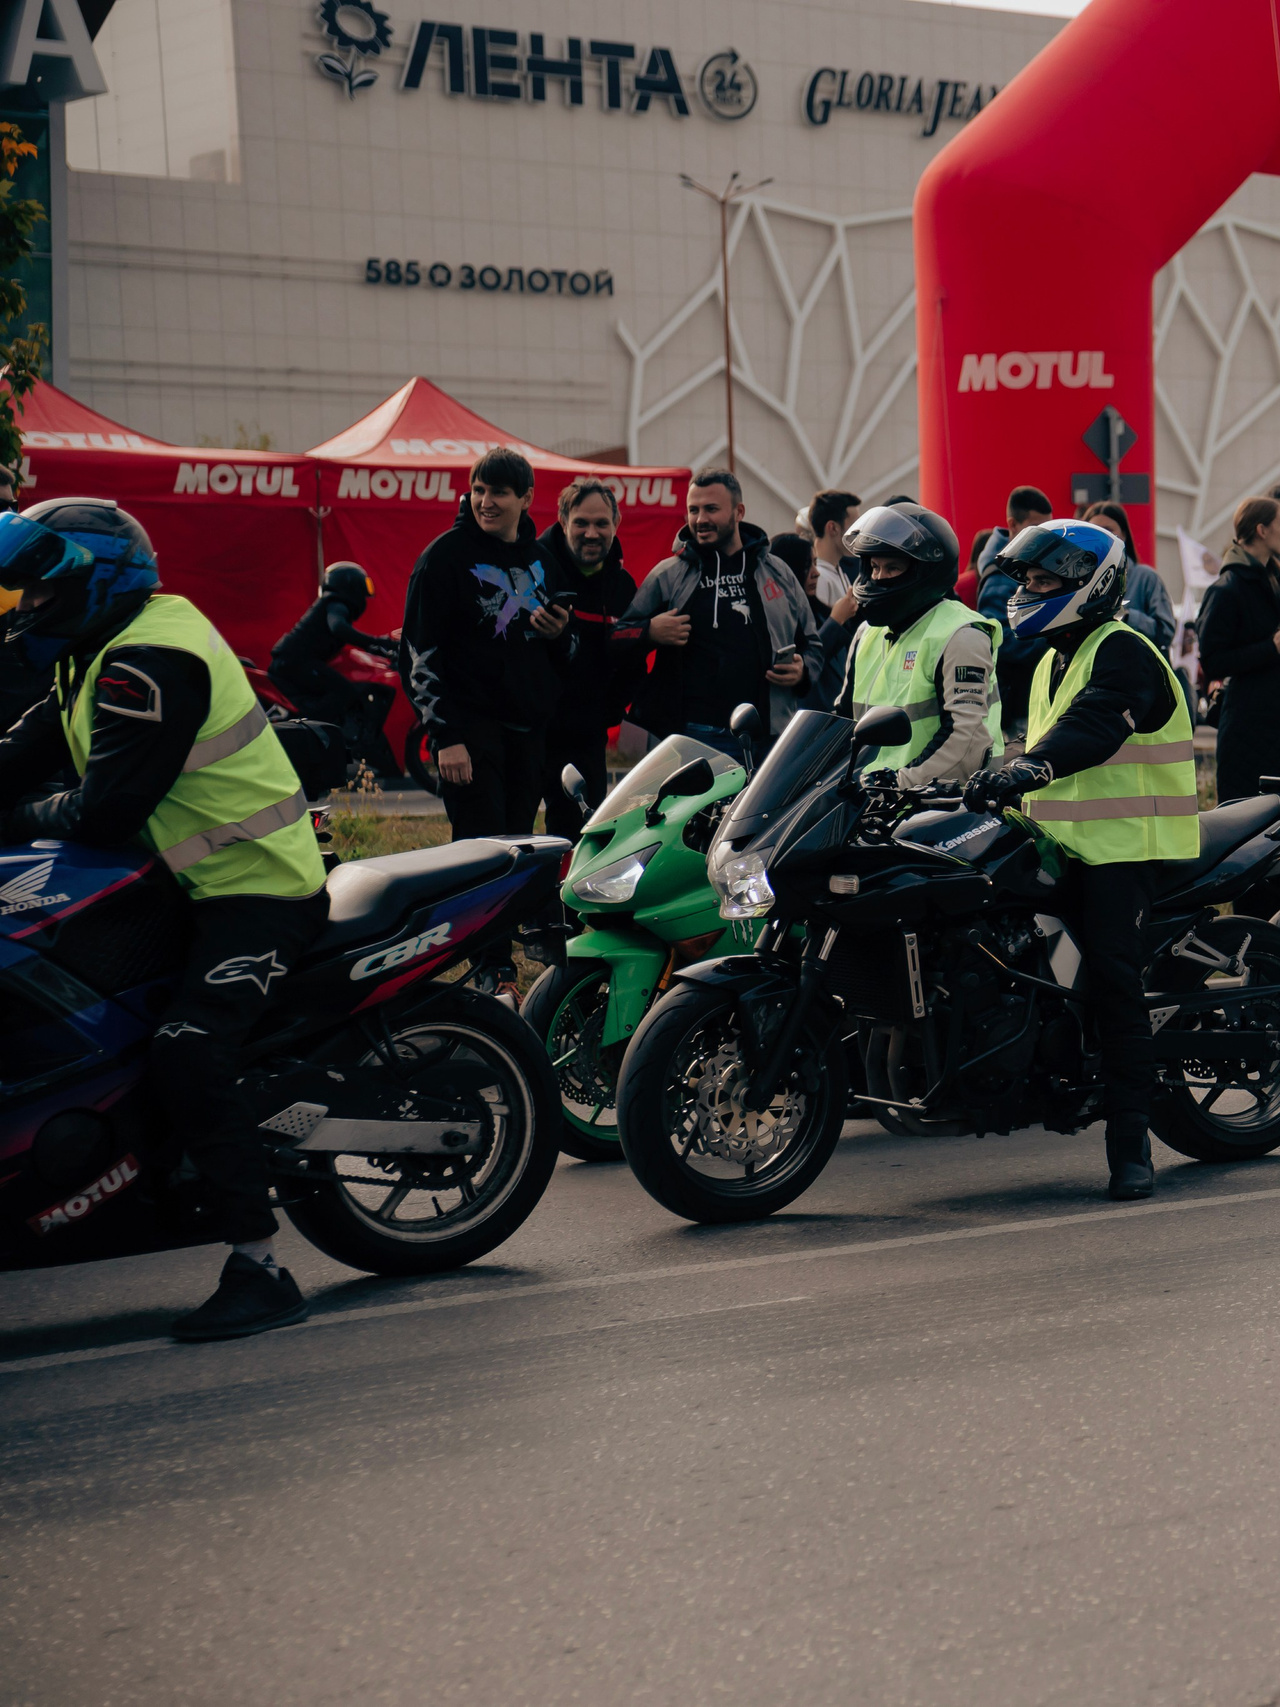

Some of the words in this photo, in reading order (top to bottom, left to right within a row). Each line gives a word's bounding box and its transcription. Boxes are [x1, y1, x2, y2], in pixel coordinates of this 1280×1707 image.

[403, 20, 690, 116] ЛЕНТА
[805, 67, 923, 125] GLORIA
[365, 257, 421, 286] 585
[459, 263, 614, 297] ЗОЛОТОЙ
[957, 350, 1115, 393] MOTUL
[173, 462, 300, 498] MOTUL
[337, 468, 456, 502] MOTUL
[574, 475, 677, 507] OTUL
[933, 817, 1002, 852] Kawasaki
[0, 893, 71, 916] HONDA
[349, 922, 453, 981] CBR
[39, 1161, 138, 1233] MOTUL
